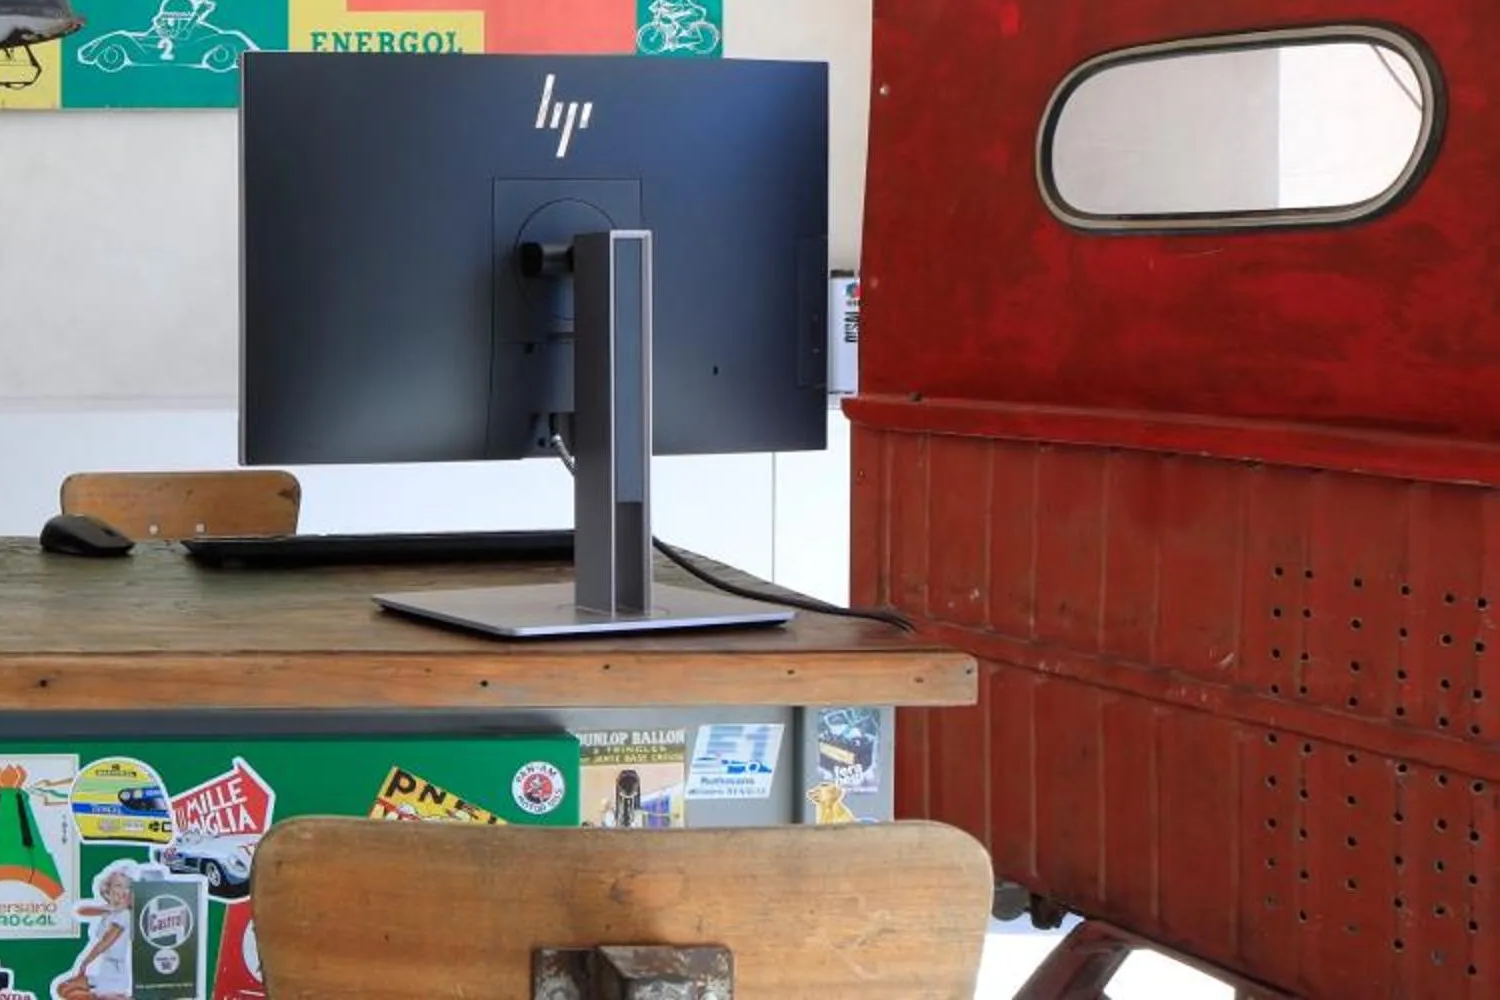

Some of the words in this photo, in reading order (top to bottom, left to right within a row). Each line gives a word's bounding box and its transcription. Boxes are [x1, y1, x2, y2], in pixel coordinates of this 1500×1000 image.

[157, 38, 175, 60] 2
[310, 31, 464, 53] ENERGOL
[631, 729, 685, 745] BALLON
[187, 777, 248, 817] MILLE
